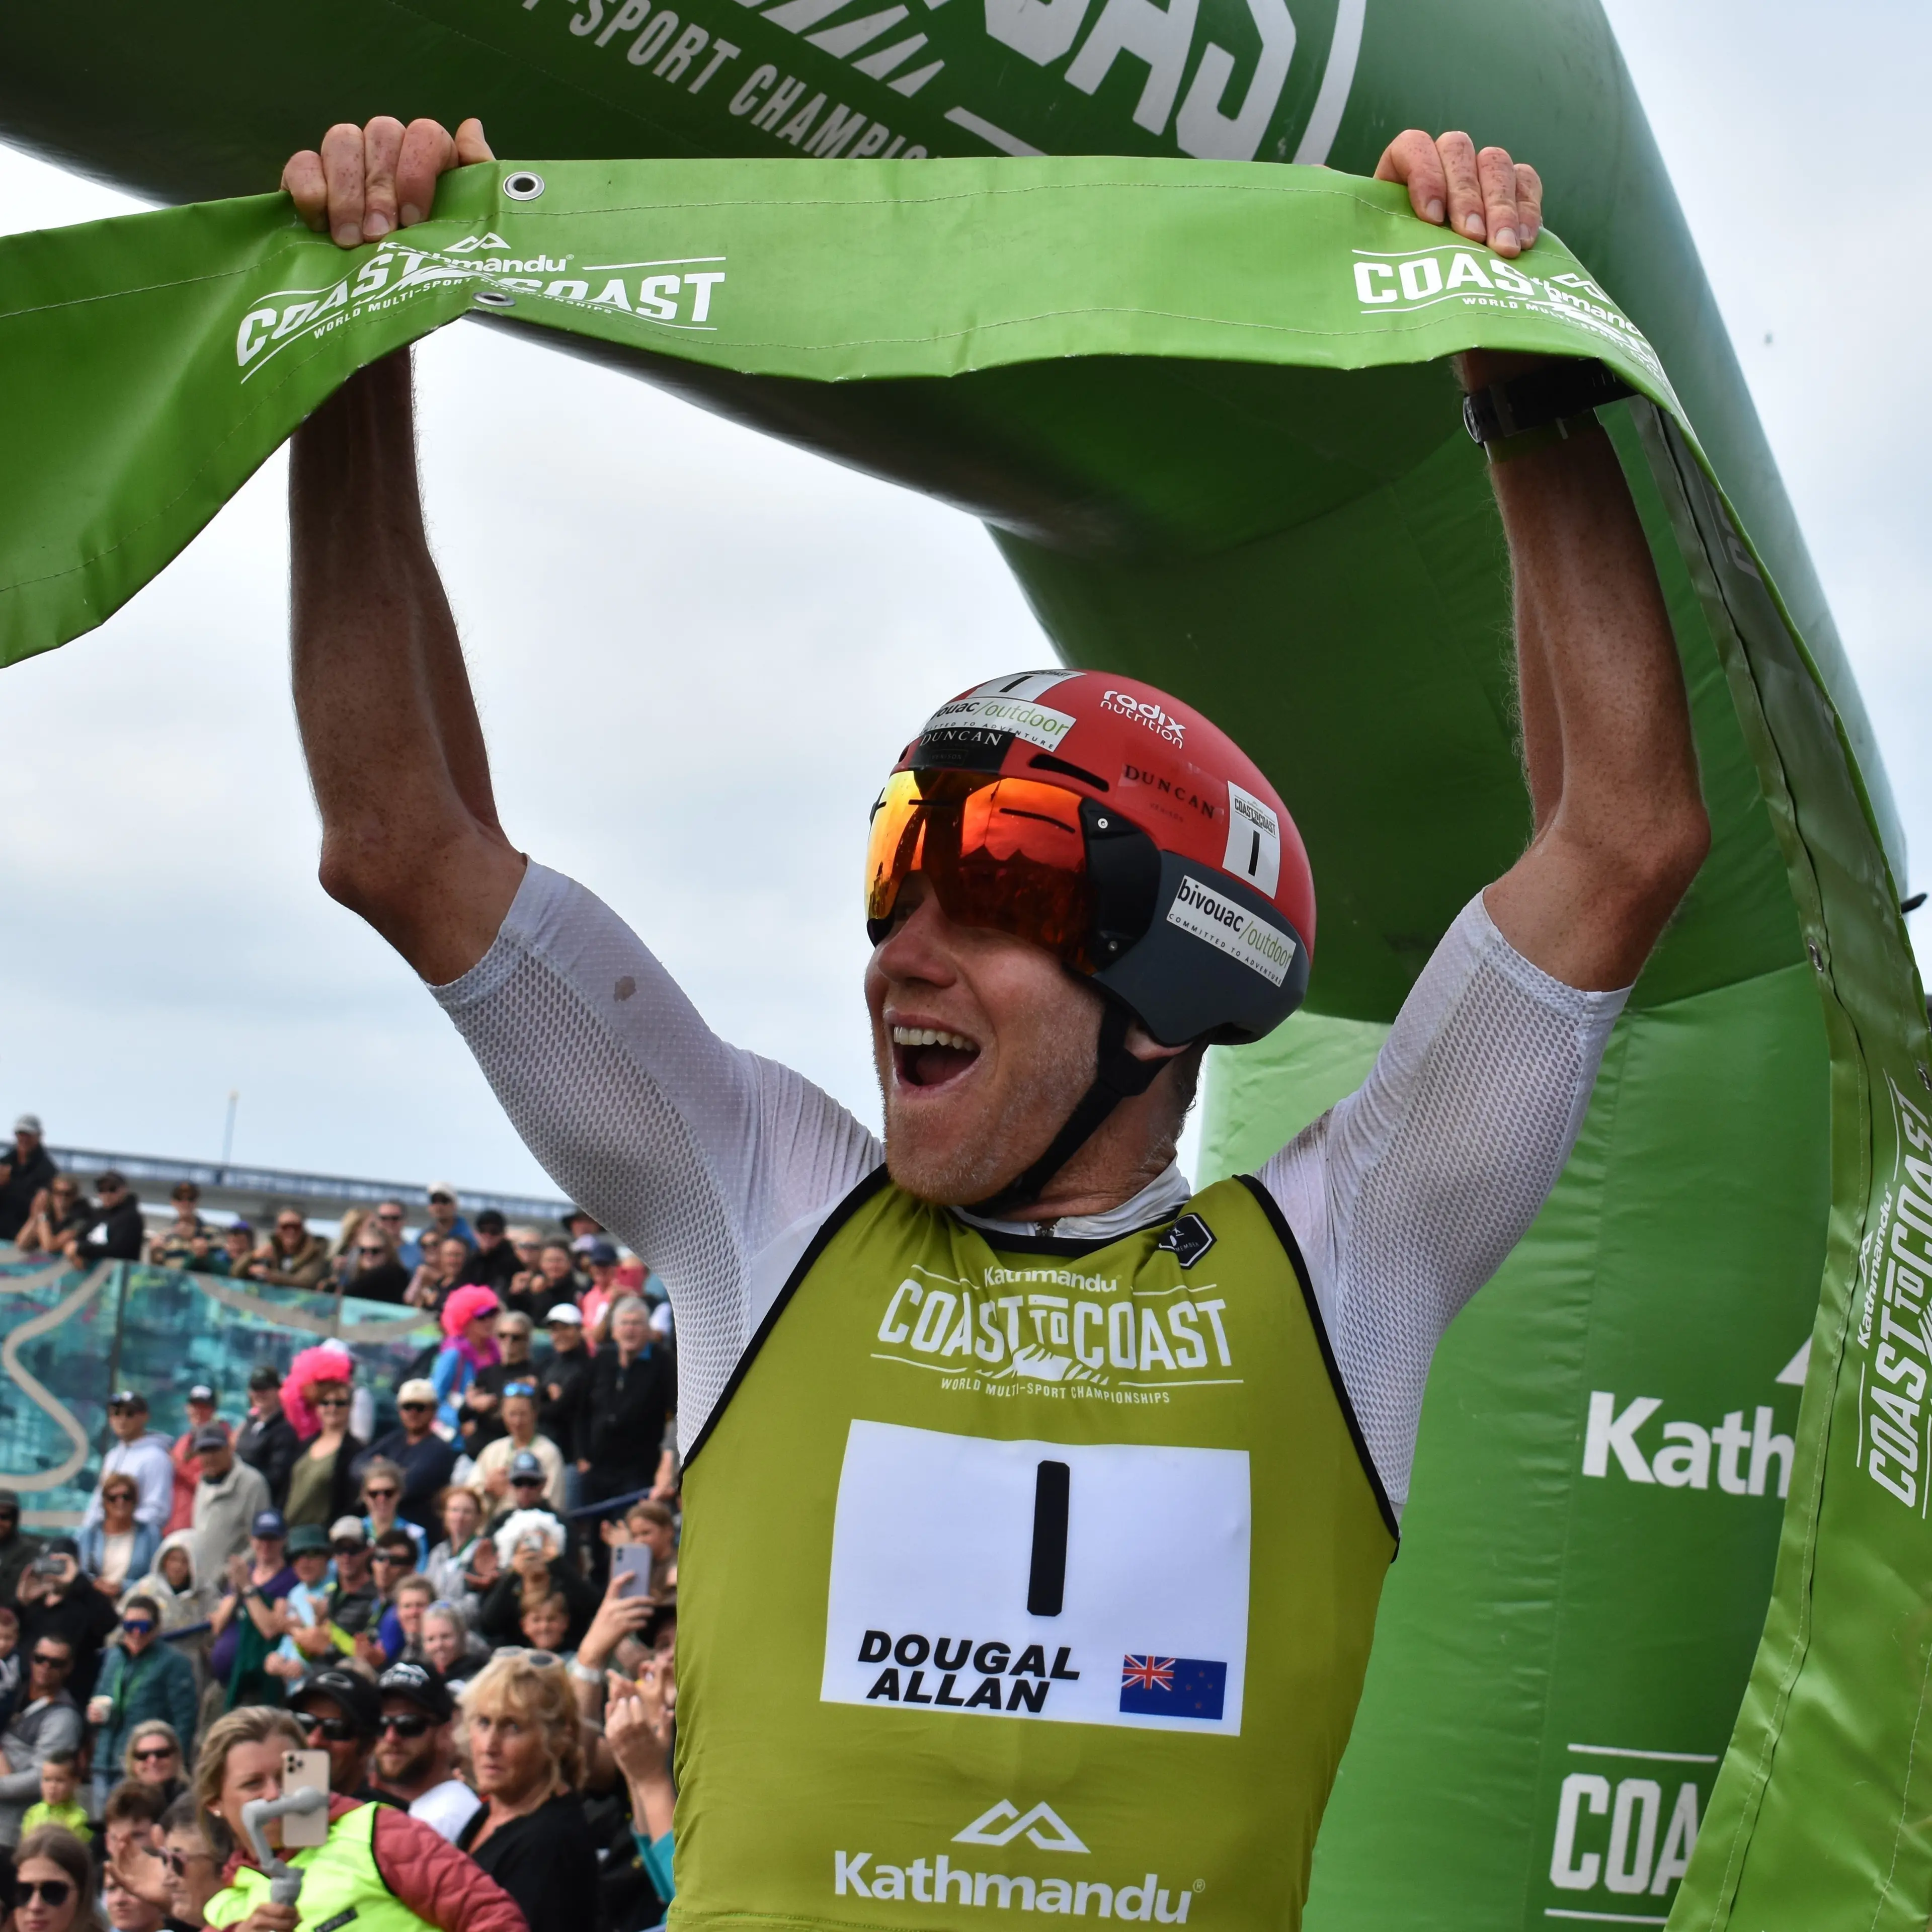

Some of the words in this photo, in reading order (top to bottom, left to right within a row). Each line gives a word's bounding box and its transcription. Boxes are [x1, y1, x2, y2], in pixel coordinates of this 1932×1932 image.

[1353, 253, 1534, 303] COAS
[313, 308, 361, 339] WORLD
[368, 277, 472, 312] MULTI-SPORT
[1462, 298, 1518, 309] WORLD
[919, 730, 1004, 747] DUNCAN
[982, 723, 1054, 750] ADVENTURE
[1100, 700, 1184, 750] nutrition
[1103, 690, 1186, 740] radix
[1124, 764, 1216, 819] DUNCAN
[1235, 798, 1255, 820] COAST
[1259, 814, 1276, 836] COAST
[1169, 913, 1226, 948] COMMITTED
[1231, 947, 1241, 956] TO
[1244, 956, 1281, 985] ADVENTURE
[1857, 1190, 1892, 1349] Kathmandu
[1895, 1265, 1924, 1315] TO
[877, 1279, 1023, 1363] COAST
[1029, 1309, 1068, 1345] TO
[1074, 1298, 1232, 1371] COAST
[941, 1378, 980, 1391] WORLD
[986, 1383, 1066, 1399] MULTI-SPORT
[1071, 1385, 1170, 1404] CHAMPIONSHIPS
[1869, 1304, 1927, 1508] COAST
[1582, 1390, 1795, 1499] Kath
[857, 1630, 1081, 1680] DOUGAL
[866, 1668, 1051, 1713] ALLAN
[1549, 1773, 1699, 1896] COA
